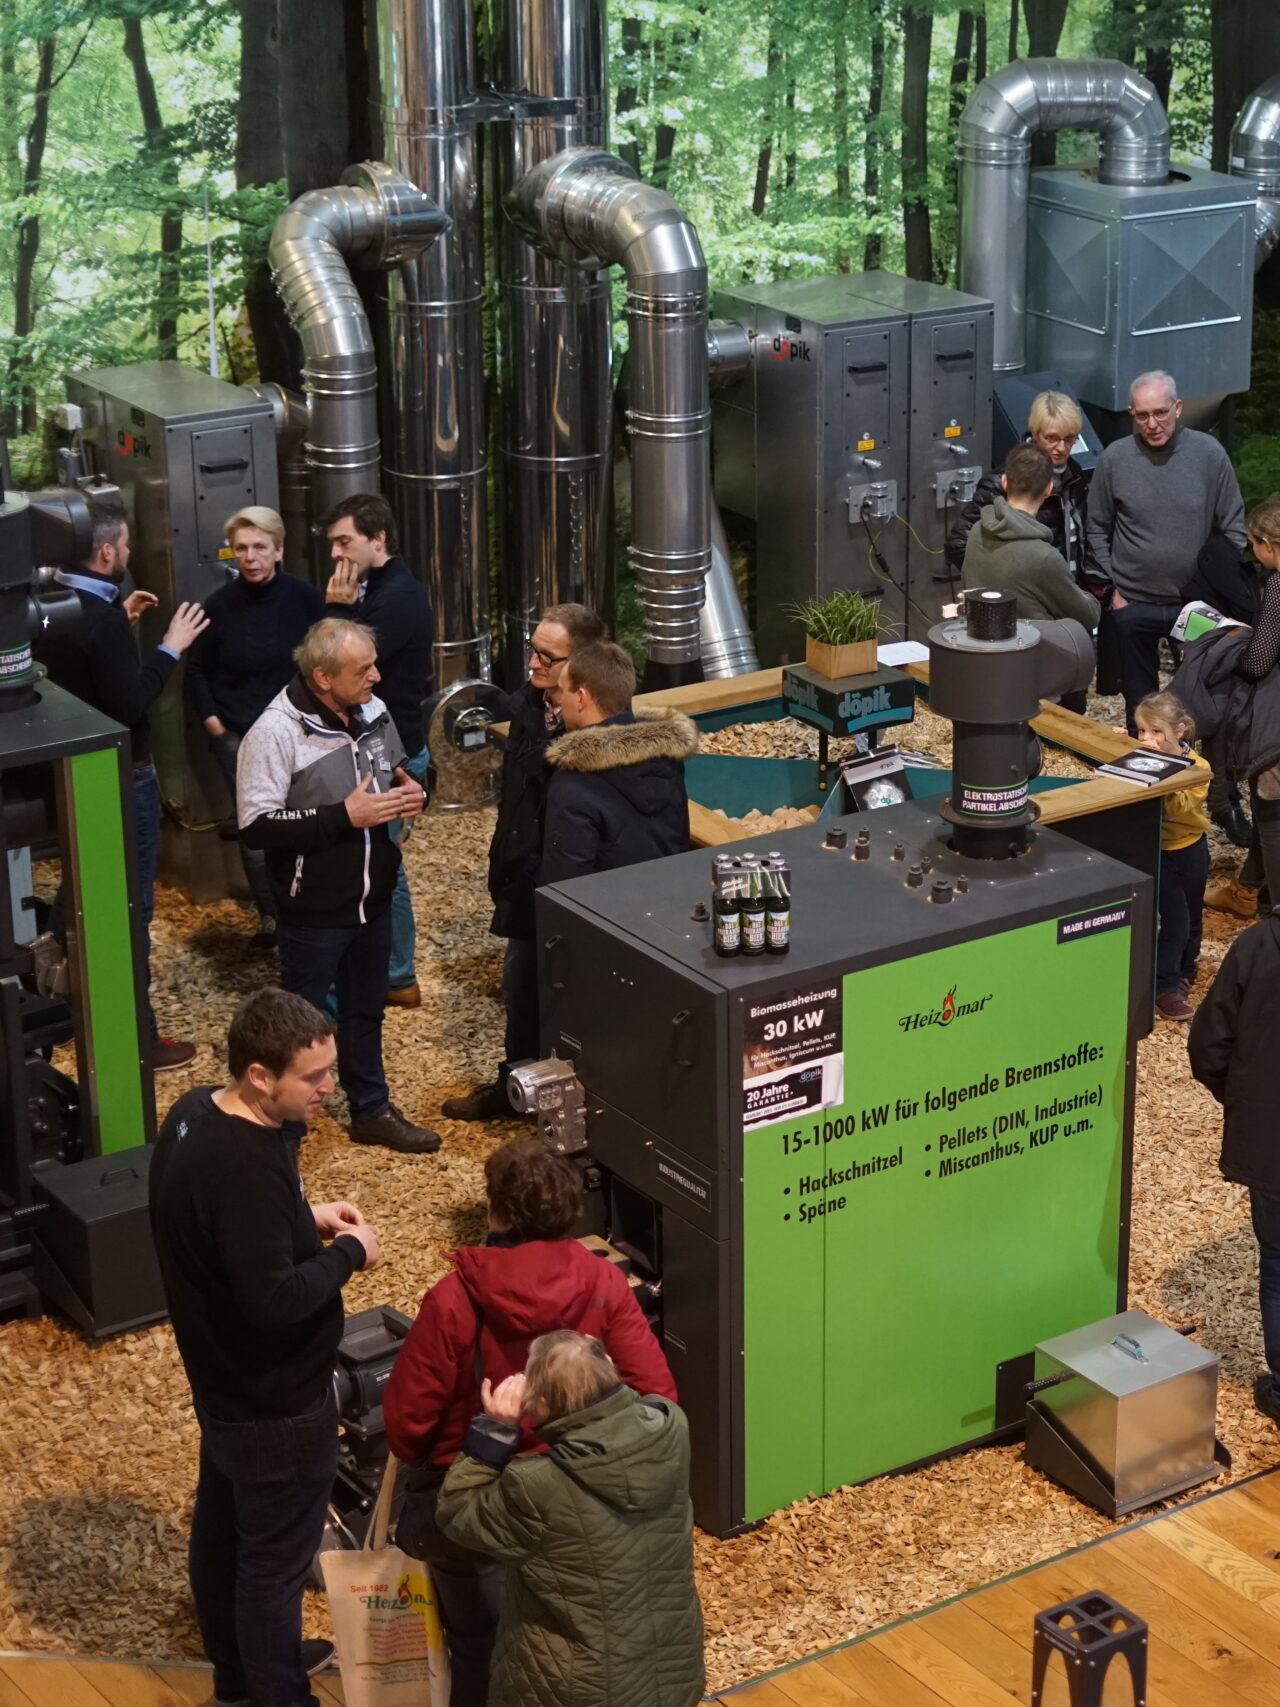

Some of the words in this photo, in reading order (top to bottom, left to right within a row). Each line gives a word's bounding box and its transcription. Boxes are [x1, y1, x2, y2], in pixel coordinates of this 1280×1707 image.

[773, 333, 811, 362] döpik
[838, 685, 892, 719] döpik
[1063, 921, 1083, 935] MADE
[1084, 919, 1092, 929] IN
[1092, 910, 1126, 927] GERMANY
[750, 988, 837, 1018] Biomasseheizung
[898, 992, 994, 1032] Heizomat
[763, 1020, 787, 1041] 30
[793, 1009, 824, 1033] kW
[800, 1068, 823, 1080] döpik
[746, 1090, 760, 1103] 20
[761, 1083, 790, 1099] Jahre
[781, 1116, 855, 1155] 15-1000
[861, 1103, 890, 1132] kW
[894, 1097, 919, 1122] für
[923, 1074, 999, 1114] folgende
[1004, 1043, 1104, 1089] Brennstoffe:
[938, 1127, 988, 1154] Pellets
[992, 1108, 1031, 1141] (DIN,
[1034, 1084, 1104, 1123] Industrie)
[938, 1143, 1025, 1179] Miscanthus,
[1029, 1127, 1059, 1151] KUP
[1063, 1117, 1094, 1138] u.m.
[799, 1146, 904, 1195] Hackschnitzel
[798, 1193, 847, 1224] Späne
[350, 1584, 367, 1593] Seit
